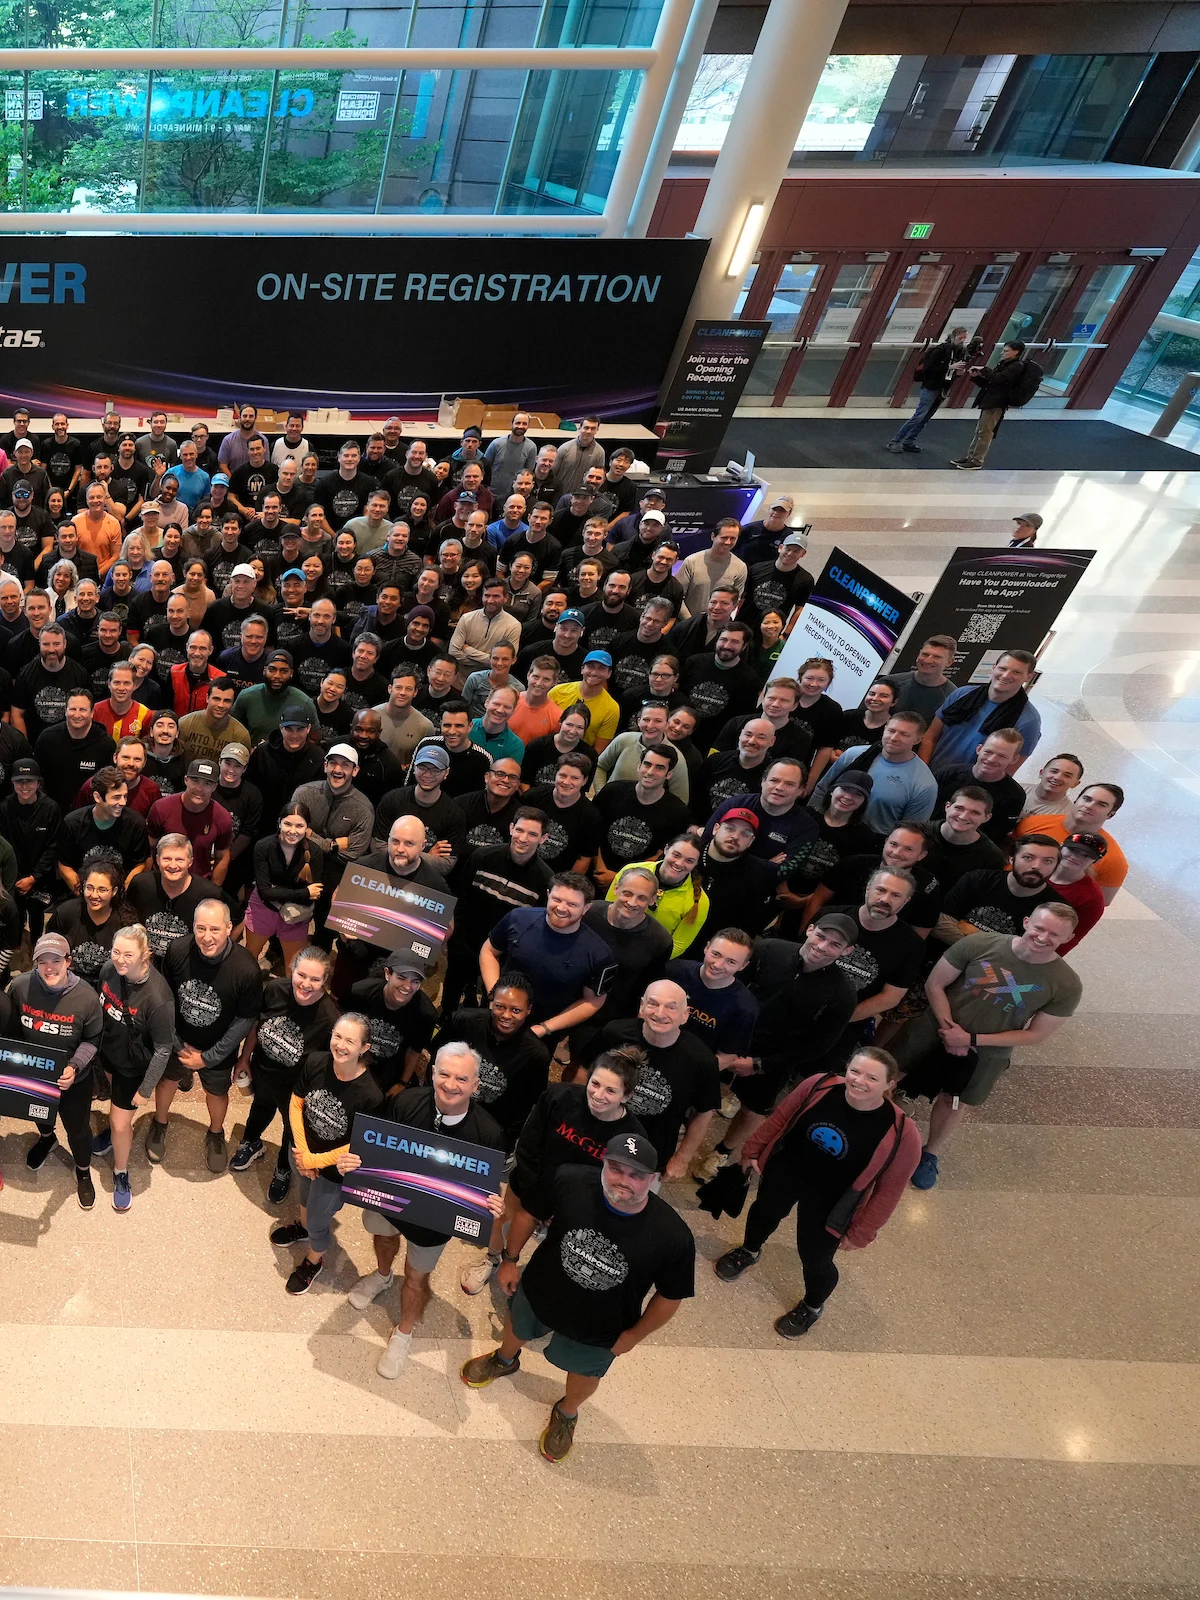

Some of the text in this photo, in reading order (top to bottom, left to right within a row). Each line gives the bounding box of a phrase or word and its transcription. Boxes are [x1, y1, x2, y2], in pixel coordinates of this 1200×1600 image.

[910, 225, 930, 238] EXIT
[257, 273, 661, 303] ON-SITE REGISTRATION
[698, 329, 763, 337] CLEANPOWER
[687, 355, 705, 363] Join
[718, 355, 733, 364] for
[734, 356, 749, 364] the
[695, 365, 734, 374] Opening
[686, 374, 736, 383] Reception!
[250, 481, 262, 490] NY
[829, 566, 900, 624] CLEANPOWER
[808, 613, 871, 668] THANK YOU TO OPENING
[804, 624, 863, 676] RECEPTION SPONSORS
[617, 667, 647, 677] CLEANPOWER
[692, 692, 725, 704] CLEANPOWER
[189, 732, 209, 744] INTO
[612, 830, 648, 843] CLEANPOWER
[351, 874, 445, 914] CLEANPOWER
[22, 1004, 74, 1023] Westwood
[263, 1028, 298, 1053] CLEANPOWER
[363, 1130, 490, 1176] CLEANPOWER
[353, 1190, 380, 1201] AMERICA'S
[367, 1189, 394, 1200] POWERING
[362, 1198, 381, 1206] FUTURE
[456, 1225, 477, 1236] POWER
[458, 1220, 478, 1230] CLEAN
[566, 1241, 621, 1276] CLEANPOWER
